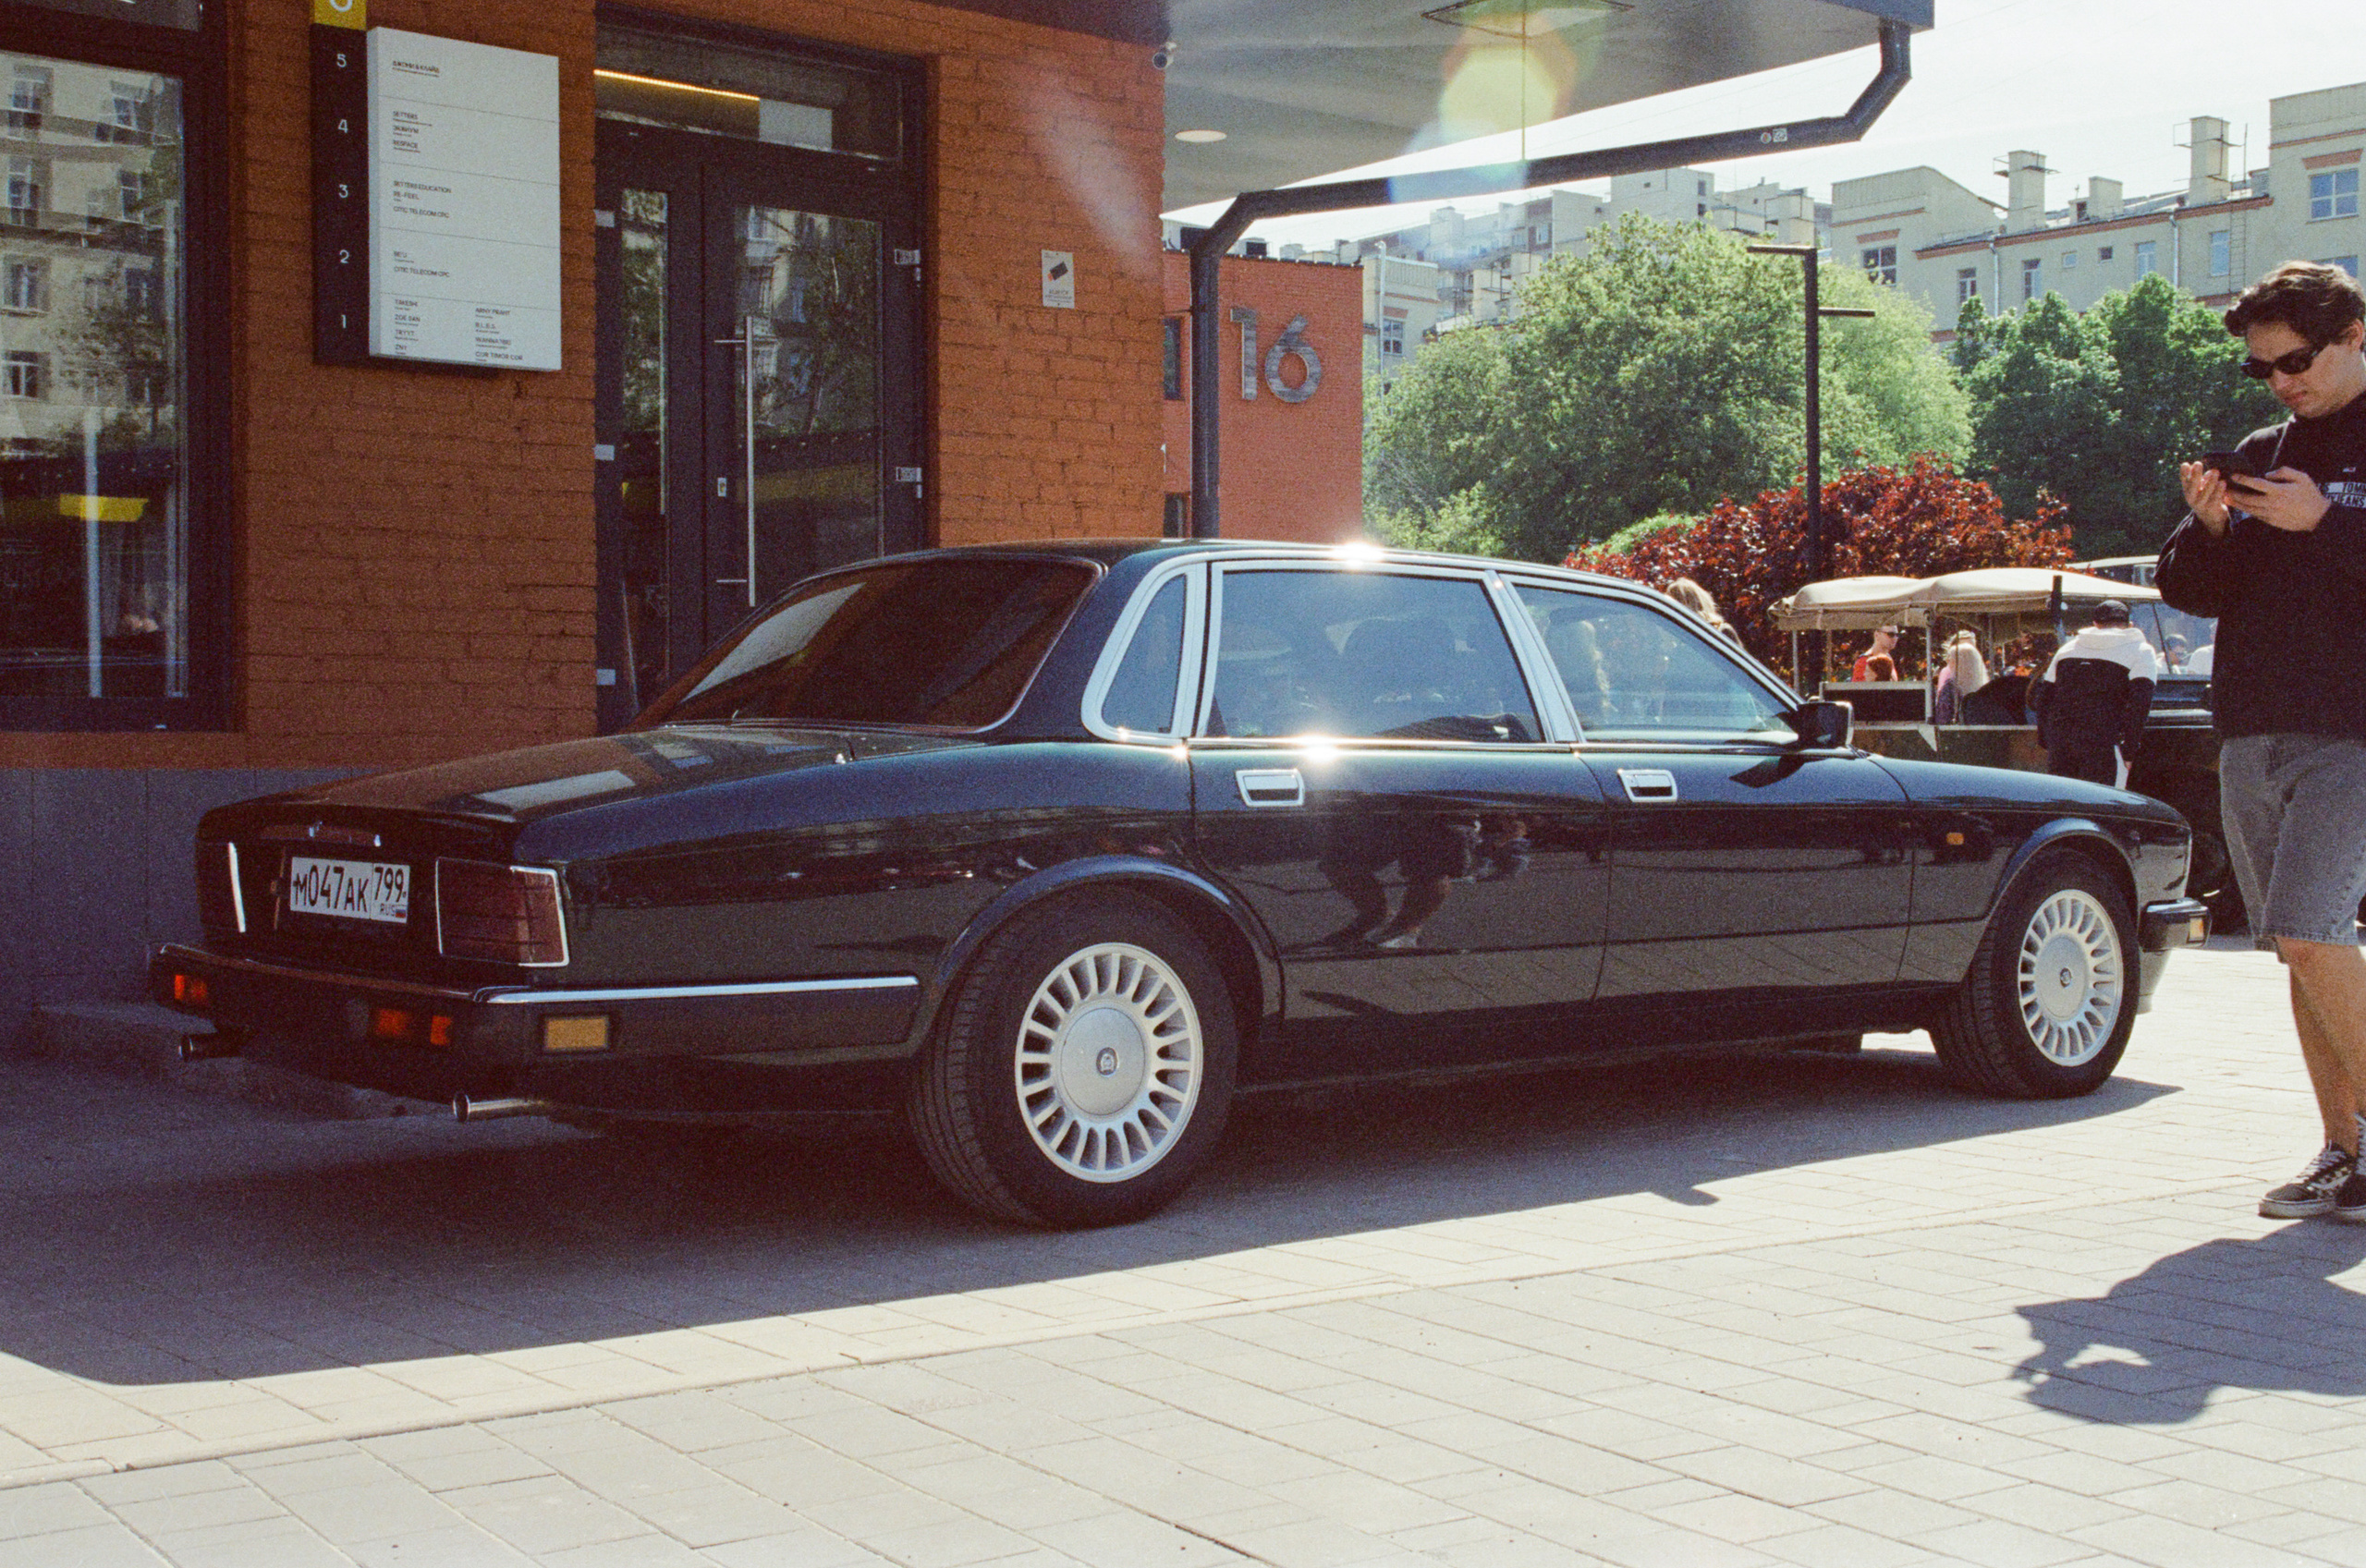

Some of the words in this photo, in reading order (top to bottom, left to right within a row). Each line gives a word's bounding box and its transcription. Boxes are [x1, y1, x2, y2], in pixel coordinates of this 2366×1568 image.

[336, 53, 348, 68] 5
[393, 110, 418, 119] SETTERS
[337, 118, 348, 134] 4
[338, 184, 349, 199] 3
[419, 184, 451, 193] EDUCATION
[409, 208, 436, 217] TELECOM
[339, 249, 350, 264] 2
[409, 267, 436, 275] TELECOM
[340, 314, 347, 329] 1
[1230, 307, 1322, 404] 16
[374, 866, 405, 903] 799
[380, 903, 396, 917] RUS
